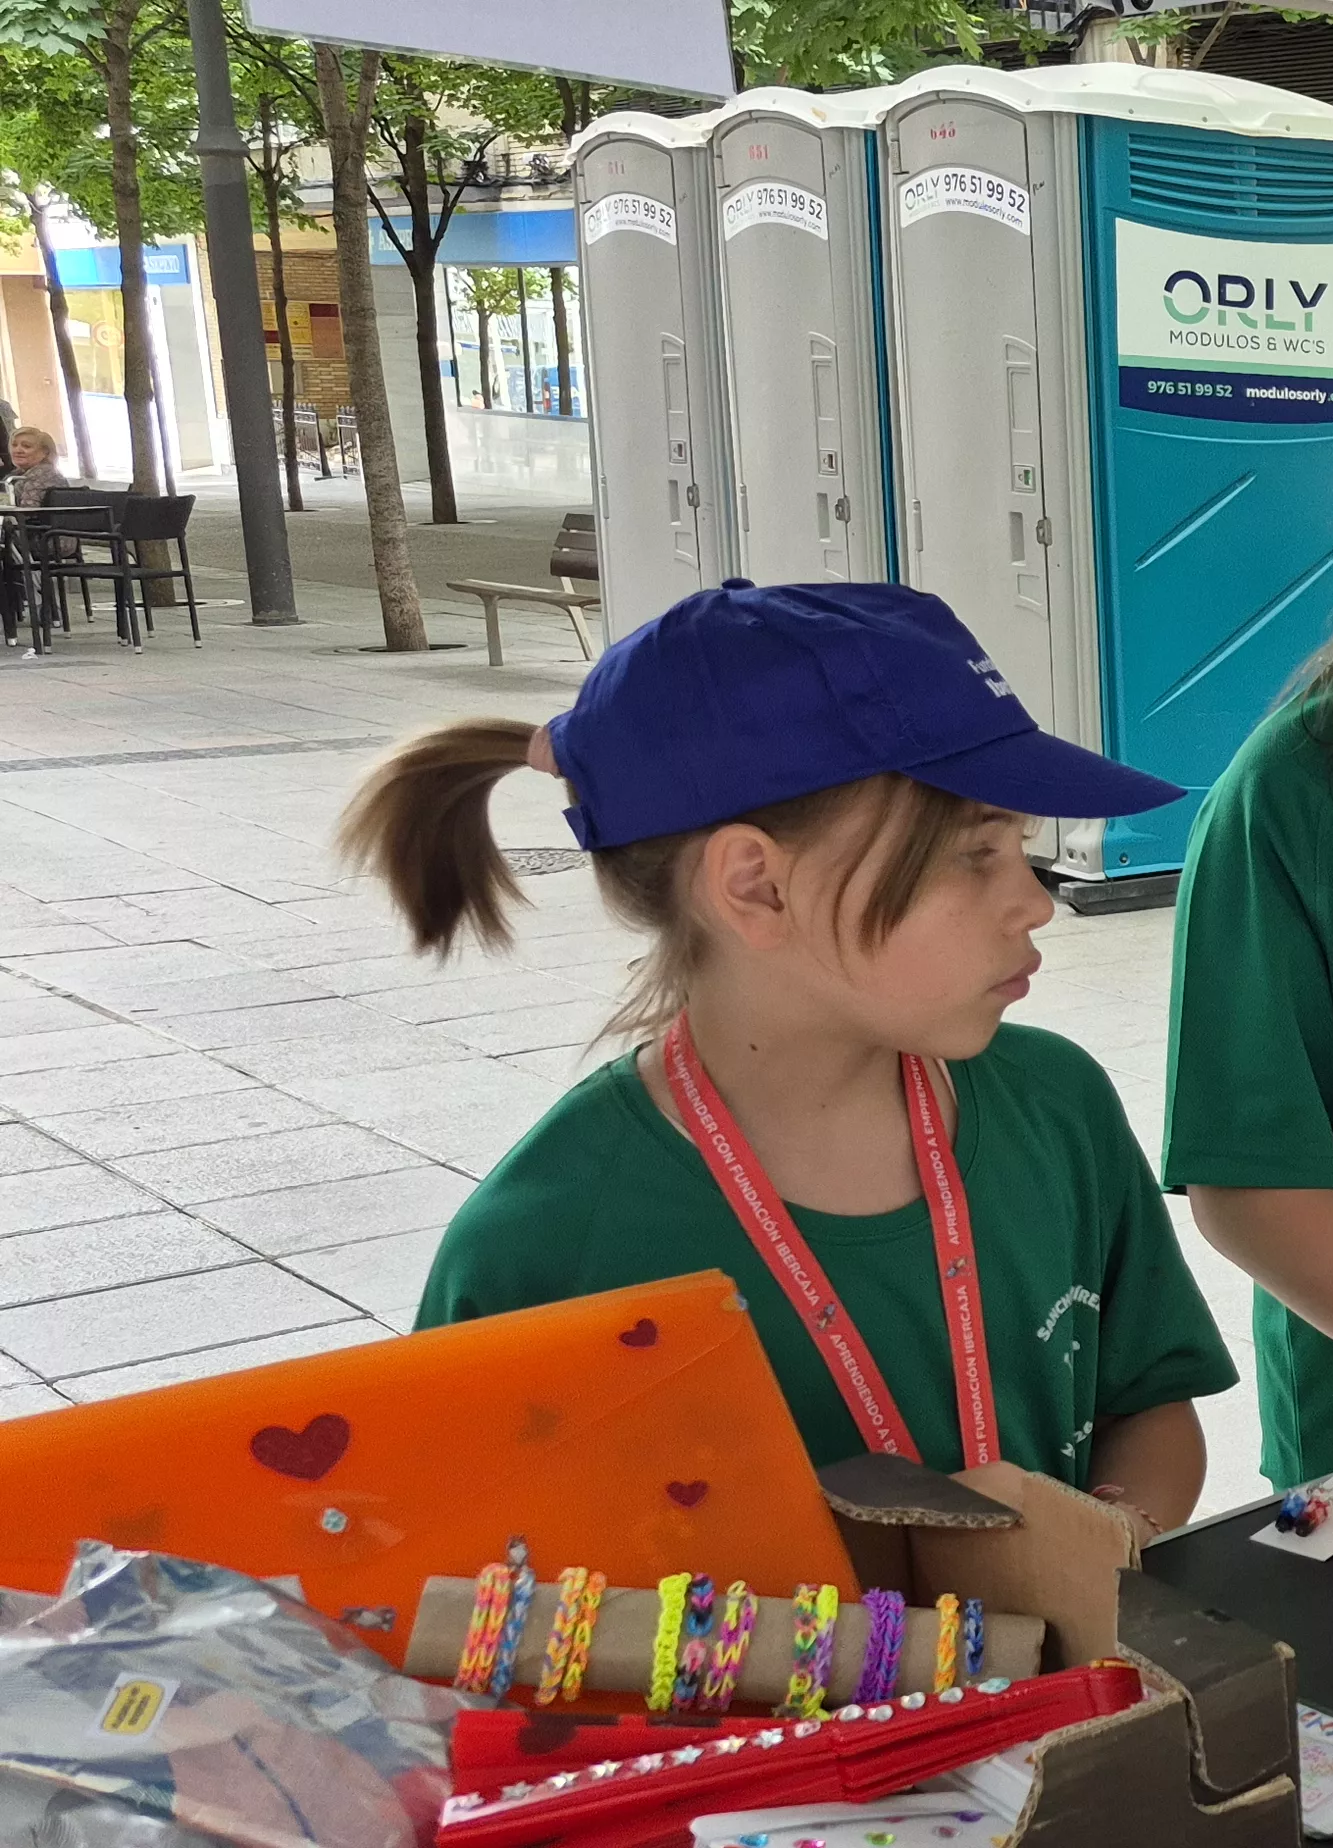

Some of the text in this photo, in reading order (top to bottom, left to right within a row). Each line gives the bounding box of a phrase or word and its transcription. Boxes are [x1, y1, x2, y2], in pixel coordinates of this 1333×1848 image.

[613, 198, 629, 215] 976
[631, 199, 641, 216] 51
[643, 201, 656, 220] 99
[659, 208, 672, 228] 52
[727, 188, 823, 225] ORLY 976 51 99 52
[905, 175, 940, 211] ORLY
[944, 173, 967, 193] 976
[970, 175, 982, 195] 51
[986, 180, 1005, 202] 99
[1008, 188, 1026, 213] 52
[1163, 269, 1329, 333] ORLY
[1169, 329, 1326, 355] MODULOS & WC'S
[1147, 380, 1175, 395] 976
[1178, 381, 1193, 396] 51
[1195, 383, 1213, 397] 99
[1215, 383, 1233, 398] 52
[927, 1136, 938, 1147] A
[672, 1053, 719, 1135] EMPRENDER
[711, 1133, 736, 1165] CON
[728, 1164, 782, 1244] FUNDACIÓN
[775, 1240, 821, 1307] IBERCAJA
[929, 1151, 961, 1246] APRENDIENDO
[957, 1284, 975, 1354] IBERCAJA
[830, 1334, 890, 1440] APRENDIENDO A
[966, 1358, 987, 1440] FUNDACIÓN
